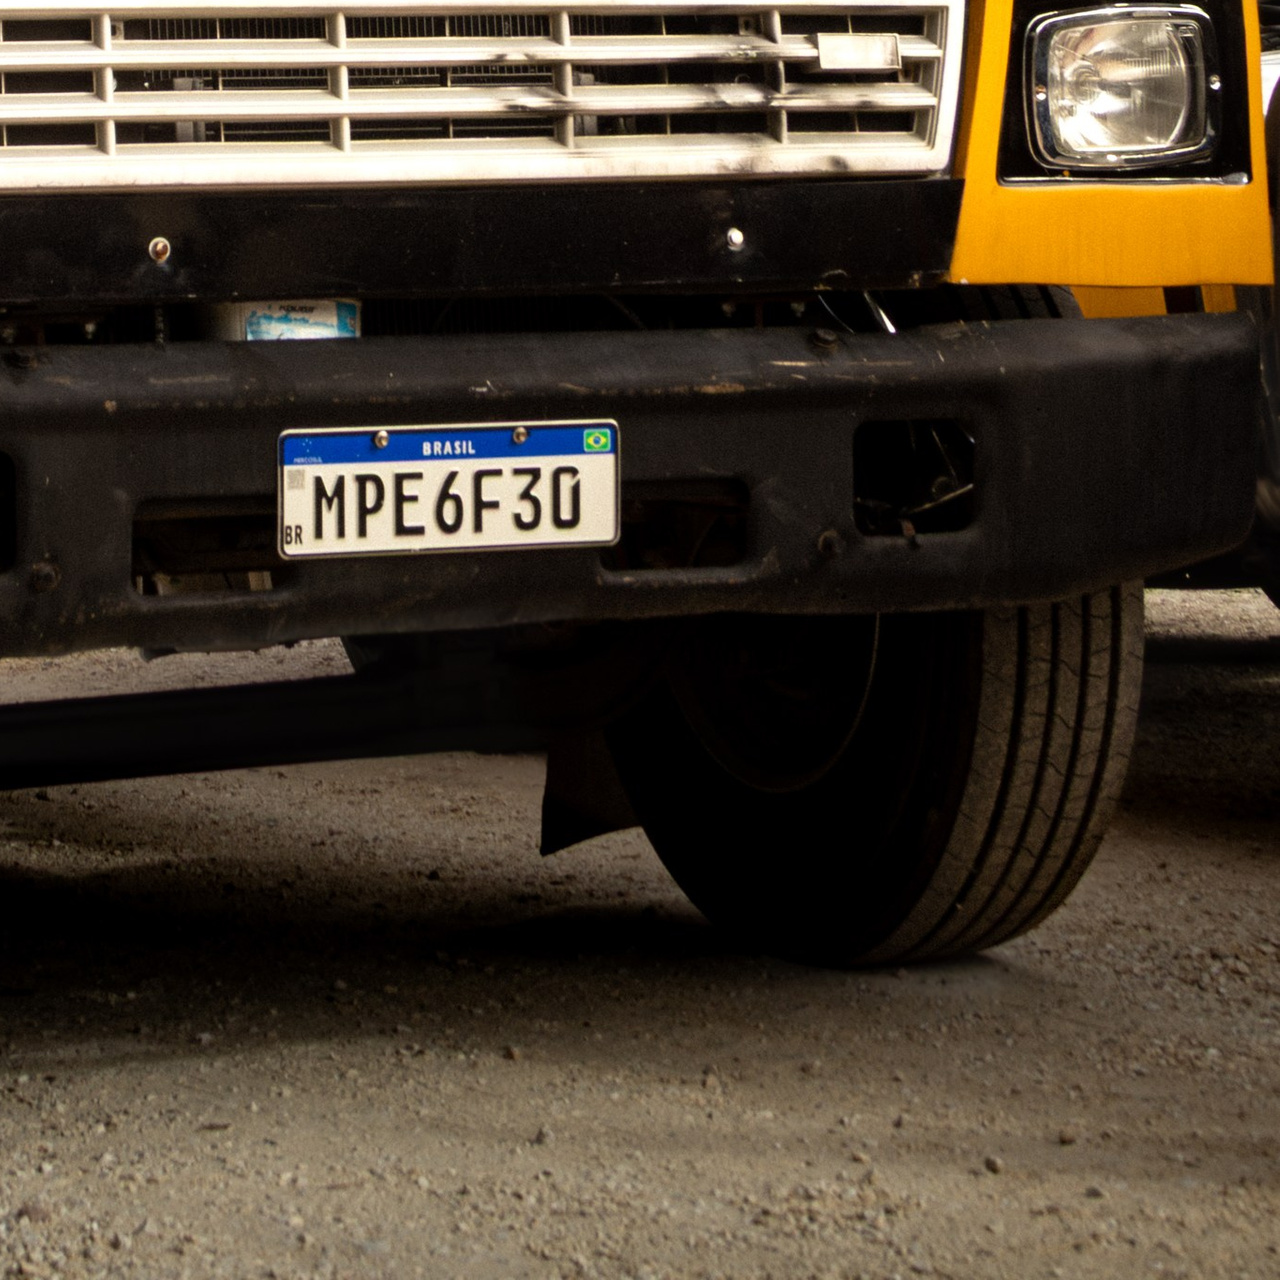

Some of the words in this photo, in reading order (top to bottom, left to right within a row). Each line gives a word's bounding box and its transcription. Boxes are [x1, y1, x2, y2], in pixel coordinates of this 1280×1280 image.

[421, 440, 476, 457] BRASIL
[312, 465, 582, 541] MPE6F30
[284, 524, 304, 546] BR
